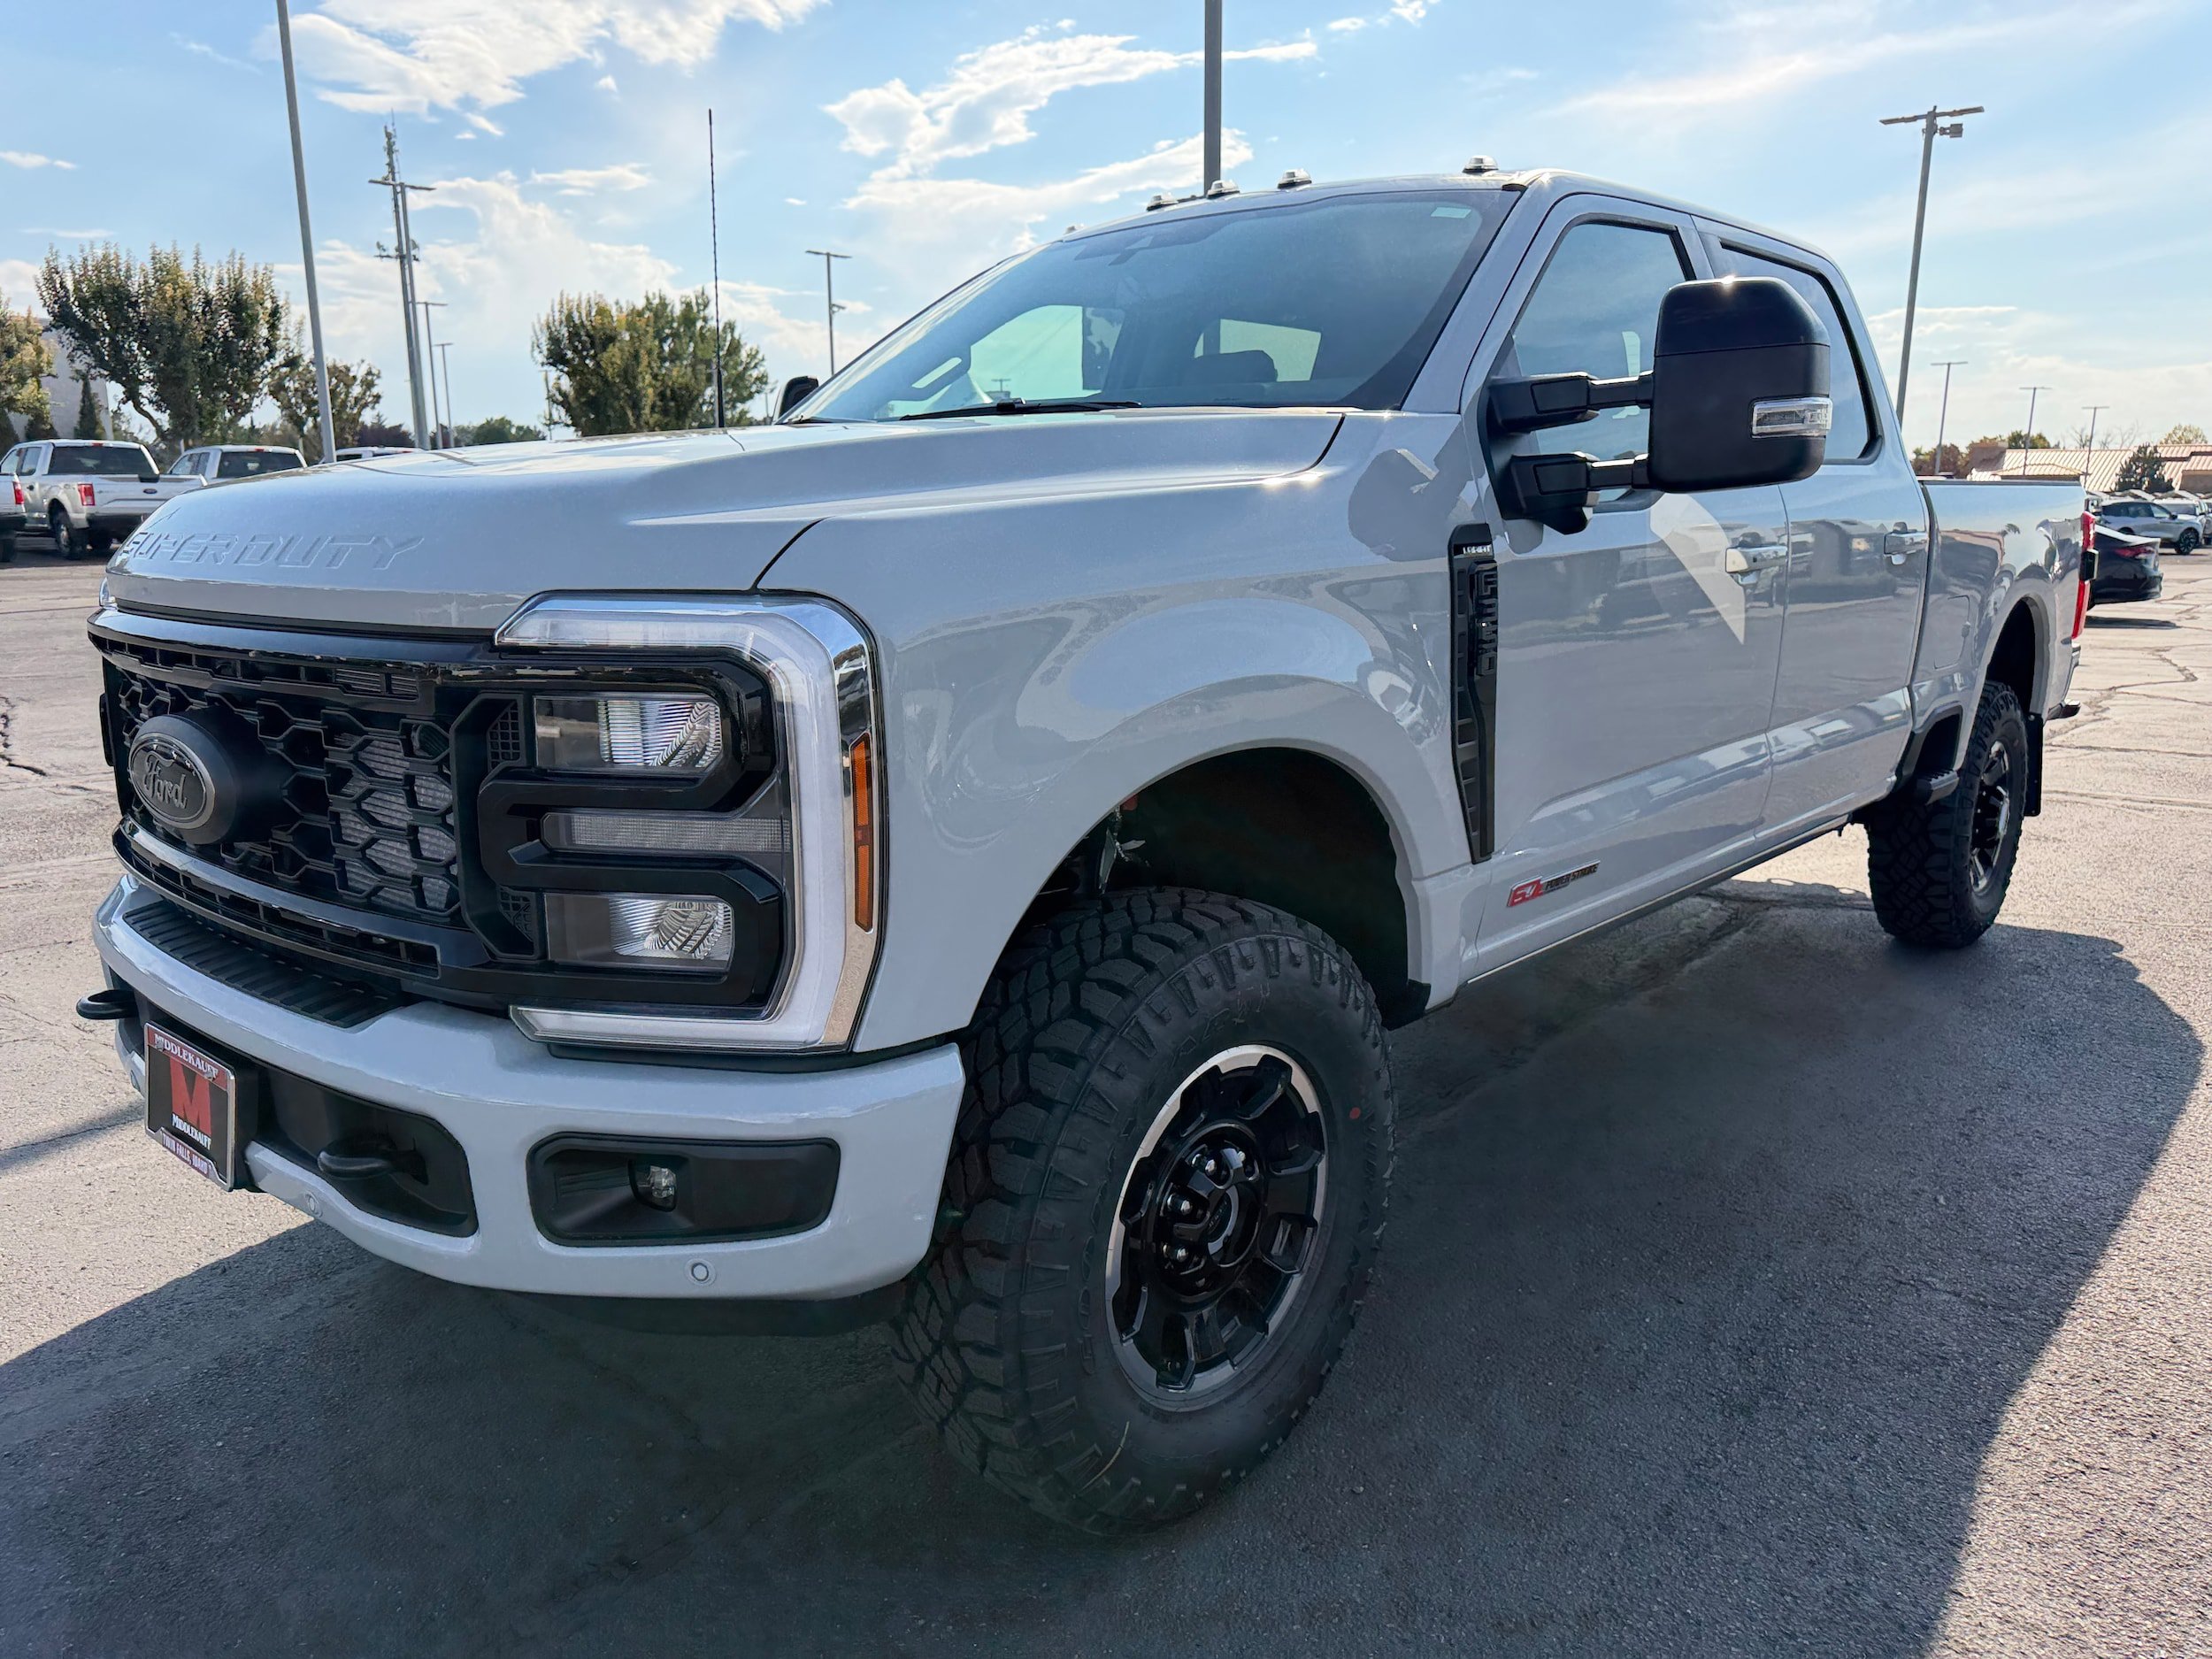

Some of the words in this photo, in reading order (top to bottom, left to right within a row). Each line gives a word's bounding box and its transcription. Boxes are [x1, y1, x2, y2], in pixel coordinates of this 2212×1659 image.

[119, 531, 239, 566] SUPER
[234, 532, 425, 571] DUTY
[142, 749, 188, 810] Ford
[171, 1112, 212, 1151] MIDDLEKAUFF
[162, 1132, 176, 1154] TWIN
[192, 1153, 208, 1175] IDAHO
